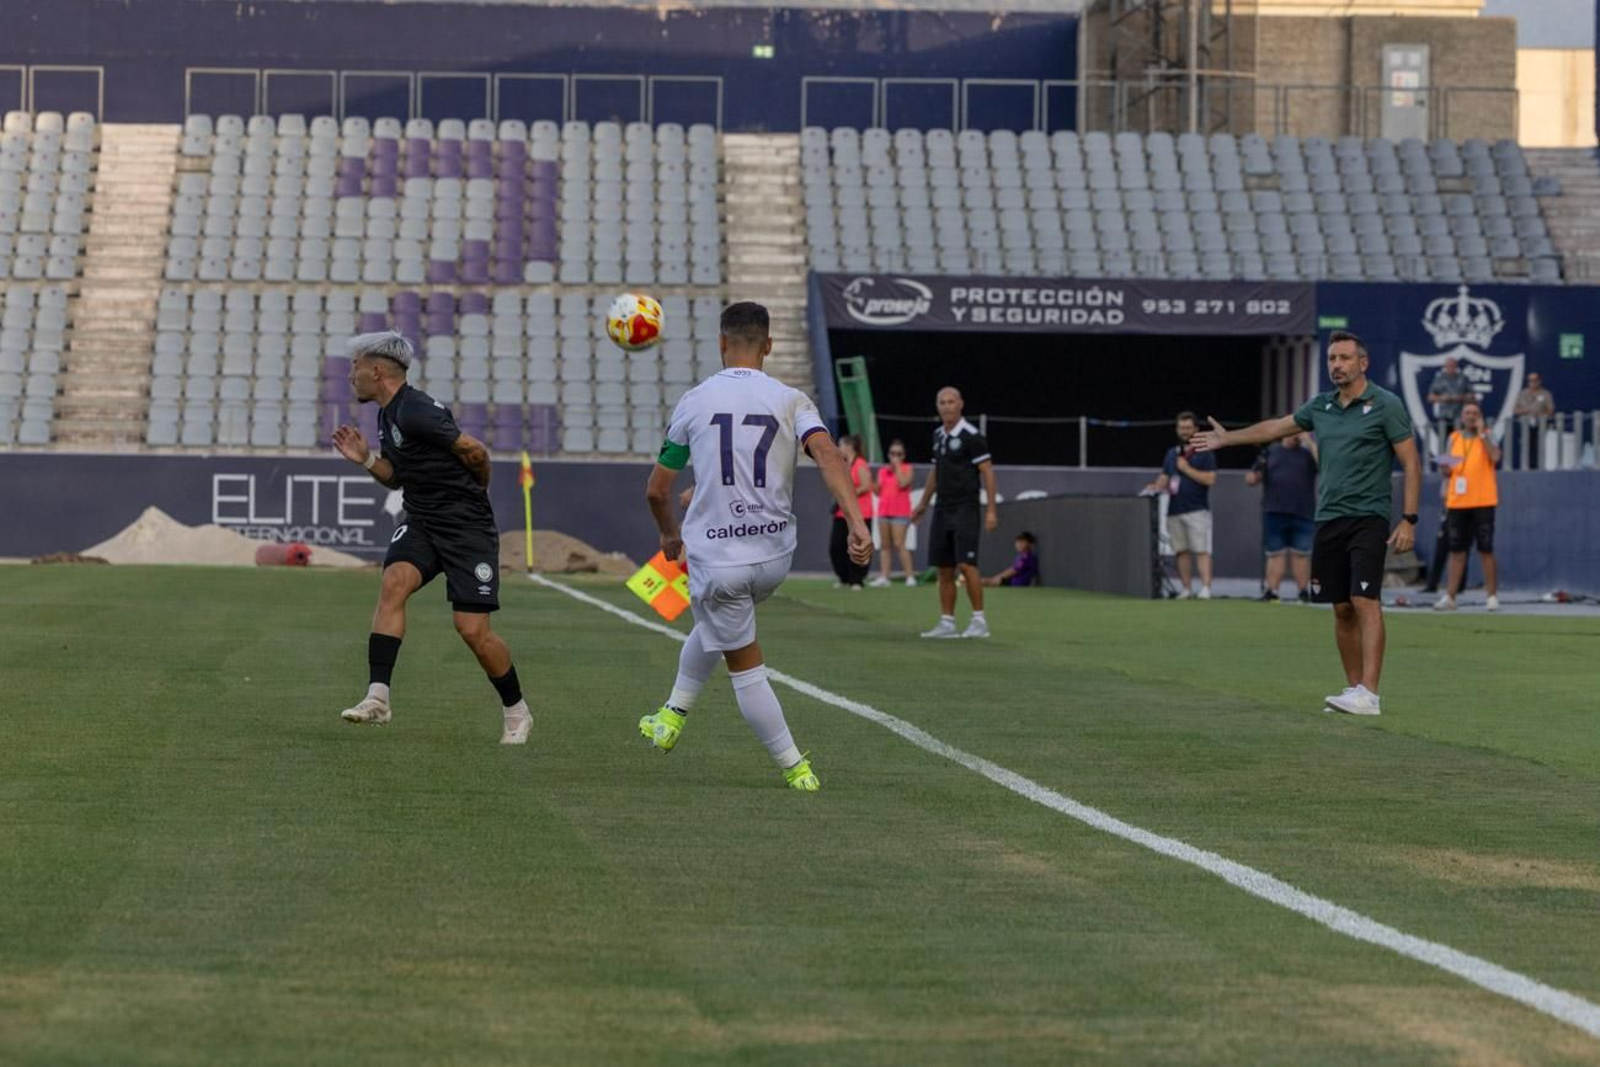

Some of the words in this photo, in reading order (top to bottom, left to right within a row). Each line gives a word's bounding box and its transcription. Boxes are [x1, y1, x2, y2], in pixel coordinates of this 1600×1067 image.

[951, 286, 1124, 305] PROTECCIÓN
[951, 306, 967, 322] Y
[971, 307, 1125, 325] SEGURIDAD
[1142, 299, 1186, 314] 953
[1194, 299, 1235, 315] 271
[709, 413, 780, 488] 17
[212, 474, 374, 526] ELITE
[230, 526, 374, 545] TERNACIONAL
[706, 519, 788, 540] calderón
